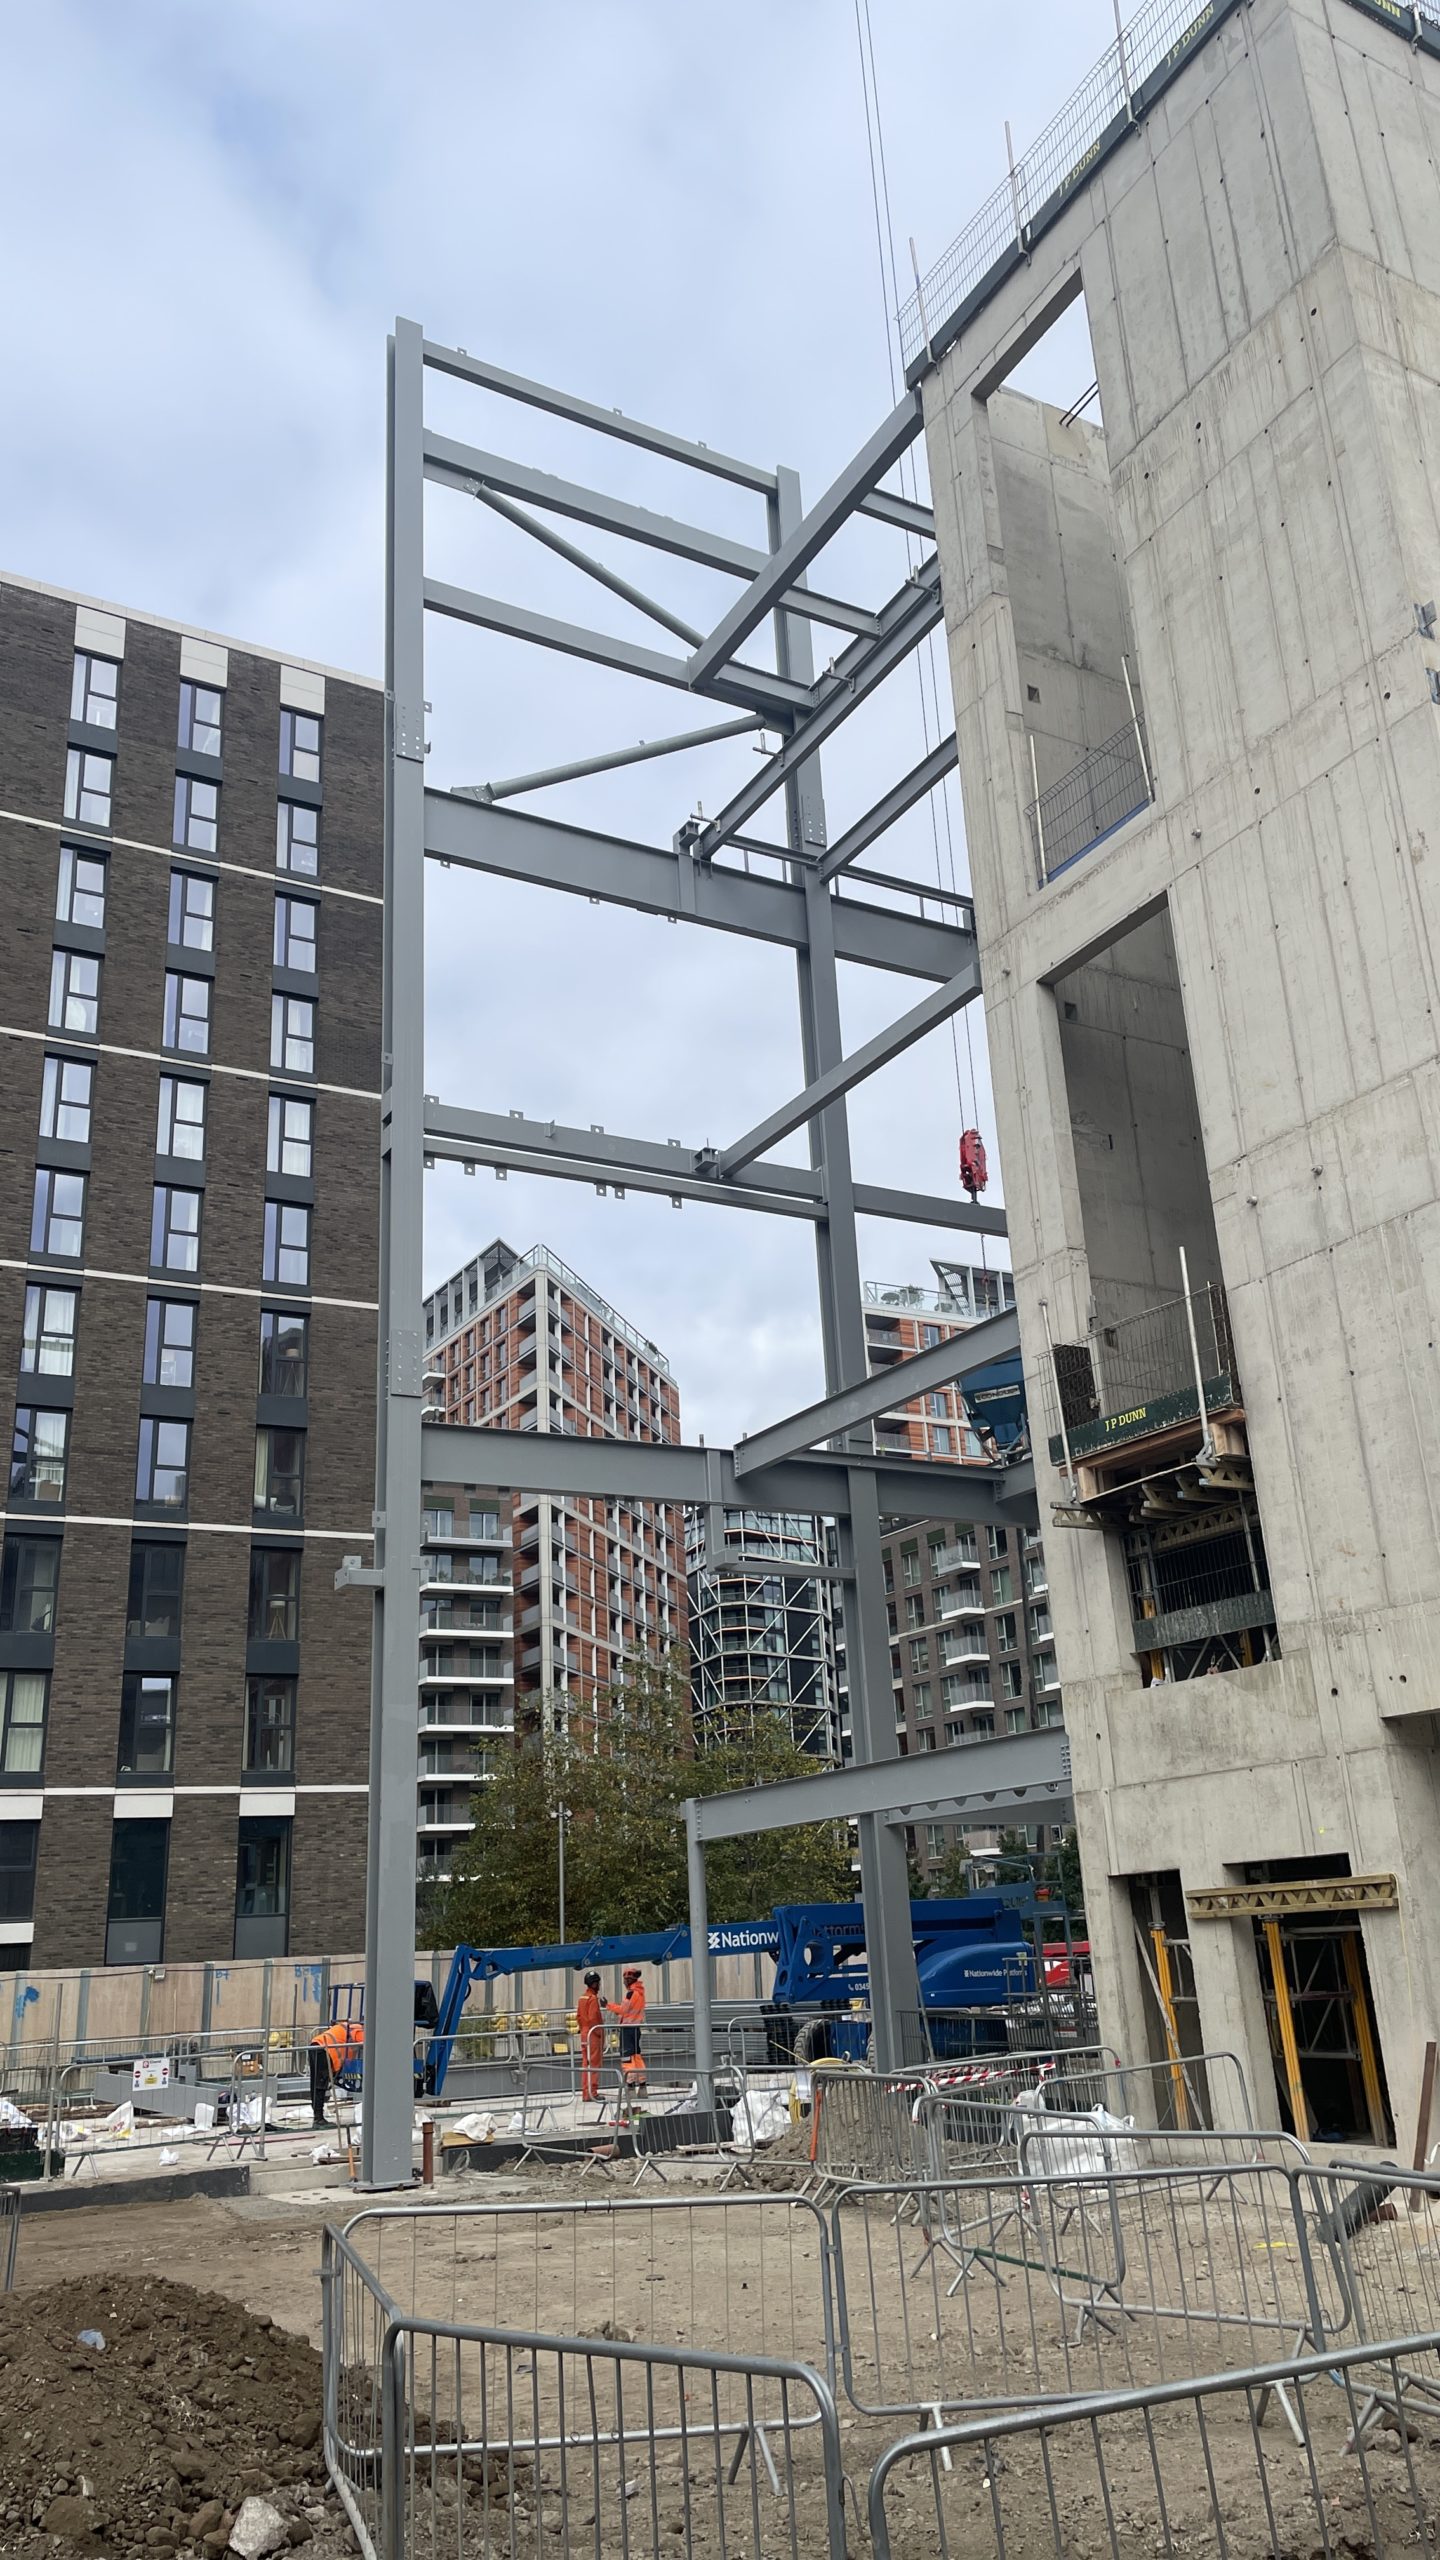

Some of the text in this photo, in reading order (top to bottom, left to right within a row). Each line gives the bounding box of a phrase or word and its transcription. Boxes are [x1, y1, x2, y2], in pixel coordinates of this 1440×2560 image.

[1166, 3, 1214, 68] J P DUNN
[1064, 176, 1071, 190] P
[1072, 140, 1101, 180] DUNN
[1104, 1407, 1147, 1432] J P DUNN
[969, 1969, 1003, 1978] Nationwide
